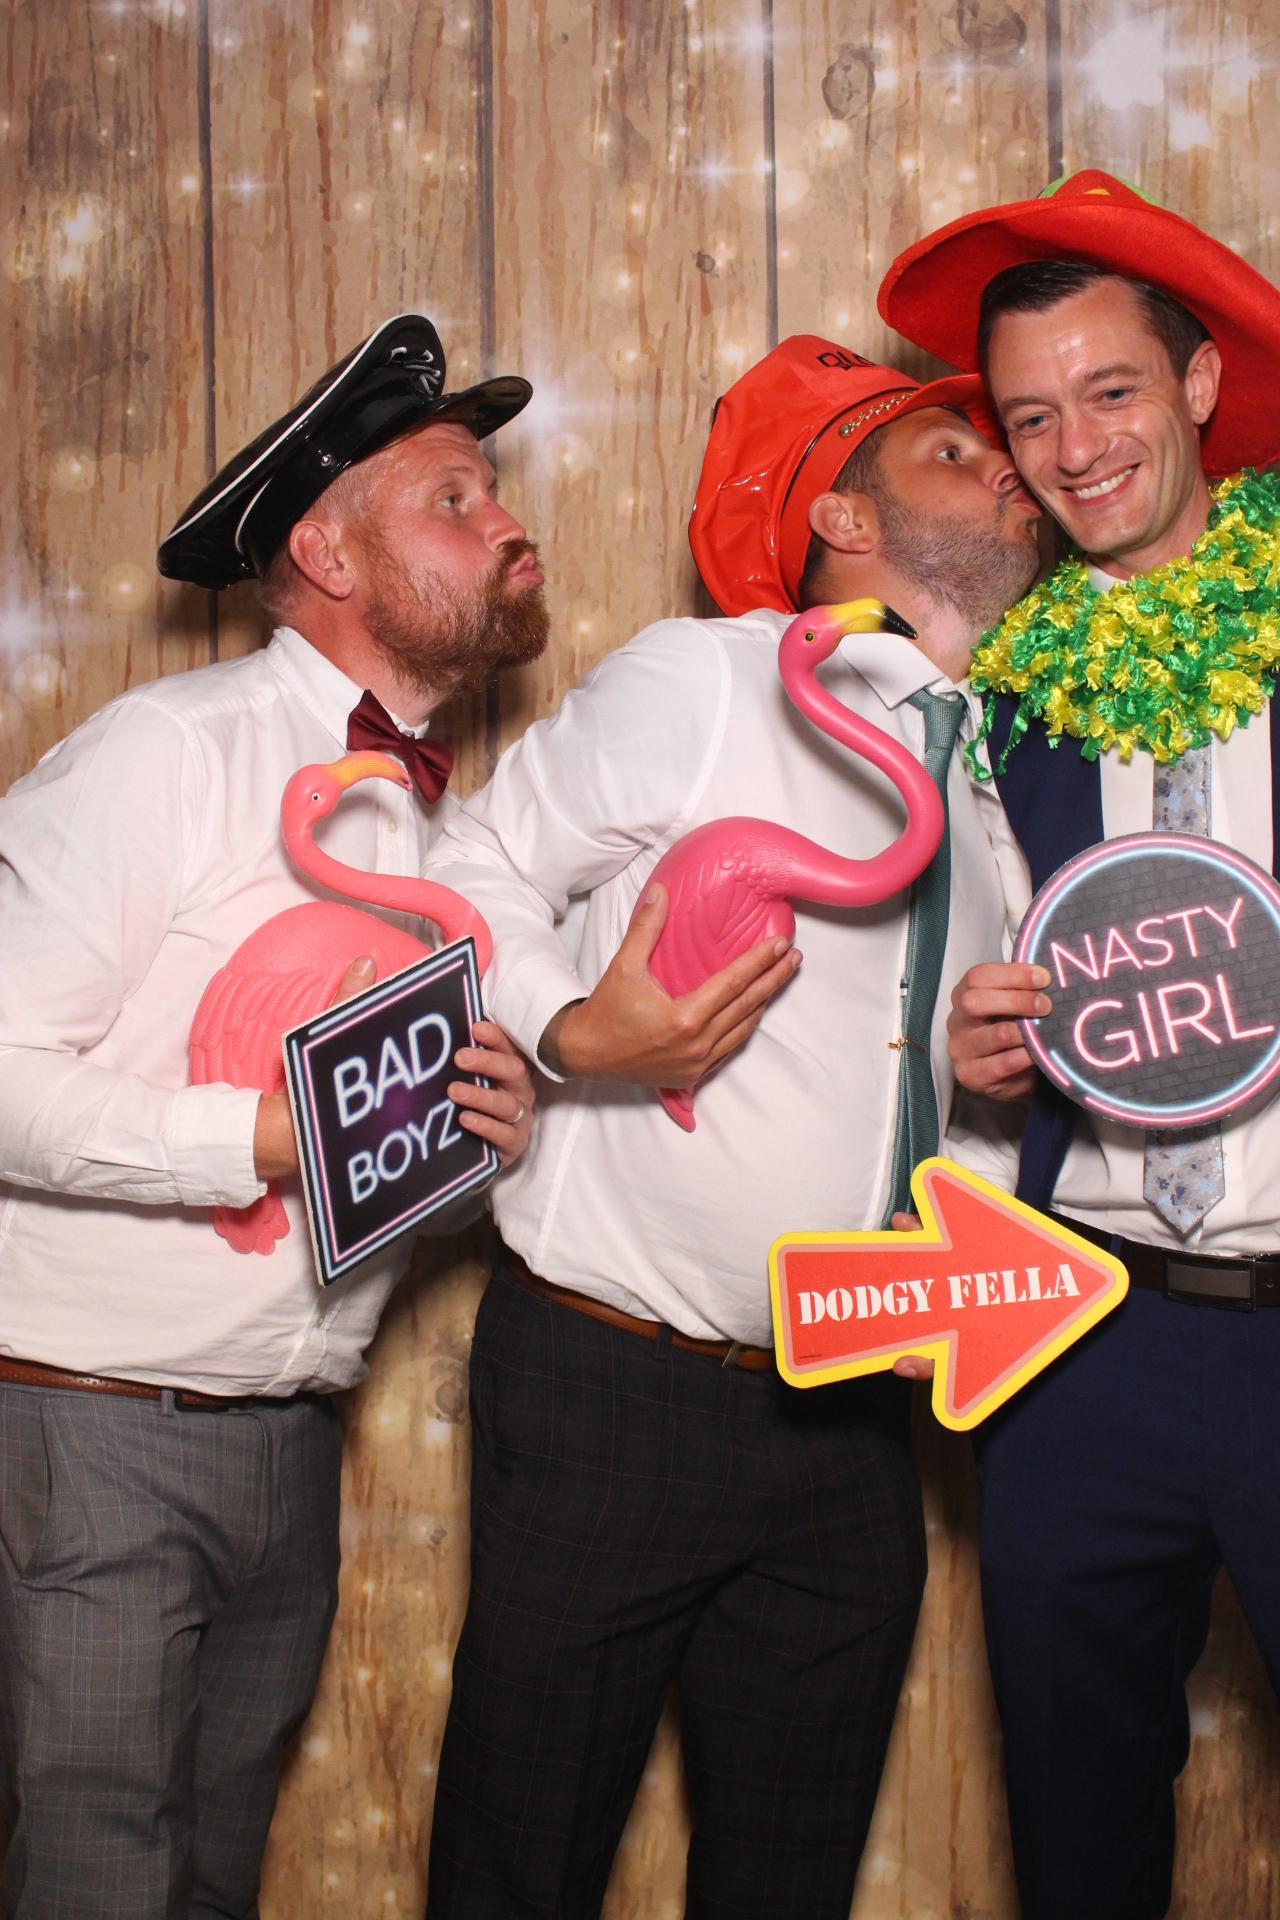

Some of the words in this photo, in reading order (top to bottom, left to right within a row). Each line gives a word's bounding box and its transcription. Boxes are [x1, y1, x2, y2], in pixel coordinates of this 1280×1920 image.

[1050, 897, 1243, 988] NASTY
[1074, 973, 1274, 1069] GIRL
[333, 1012, 452, 1129] BAD
[347, 1100, 462, 1204] BOYZ
[797, 1278, 935, 1325] DODGY
[947, 1263, 1082, 1310] FELLA
